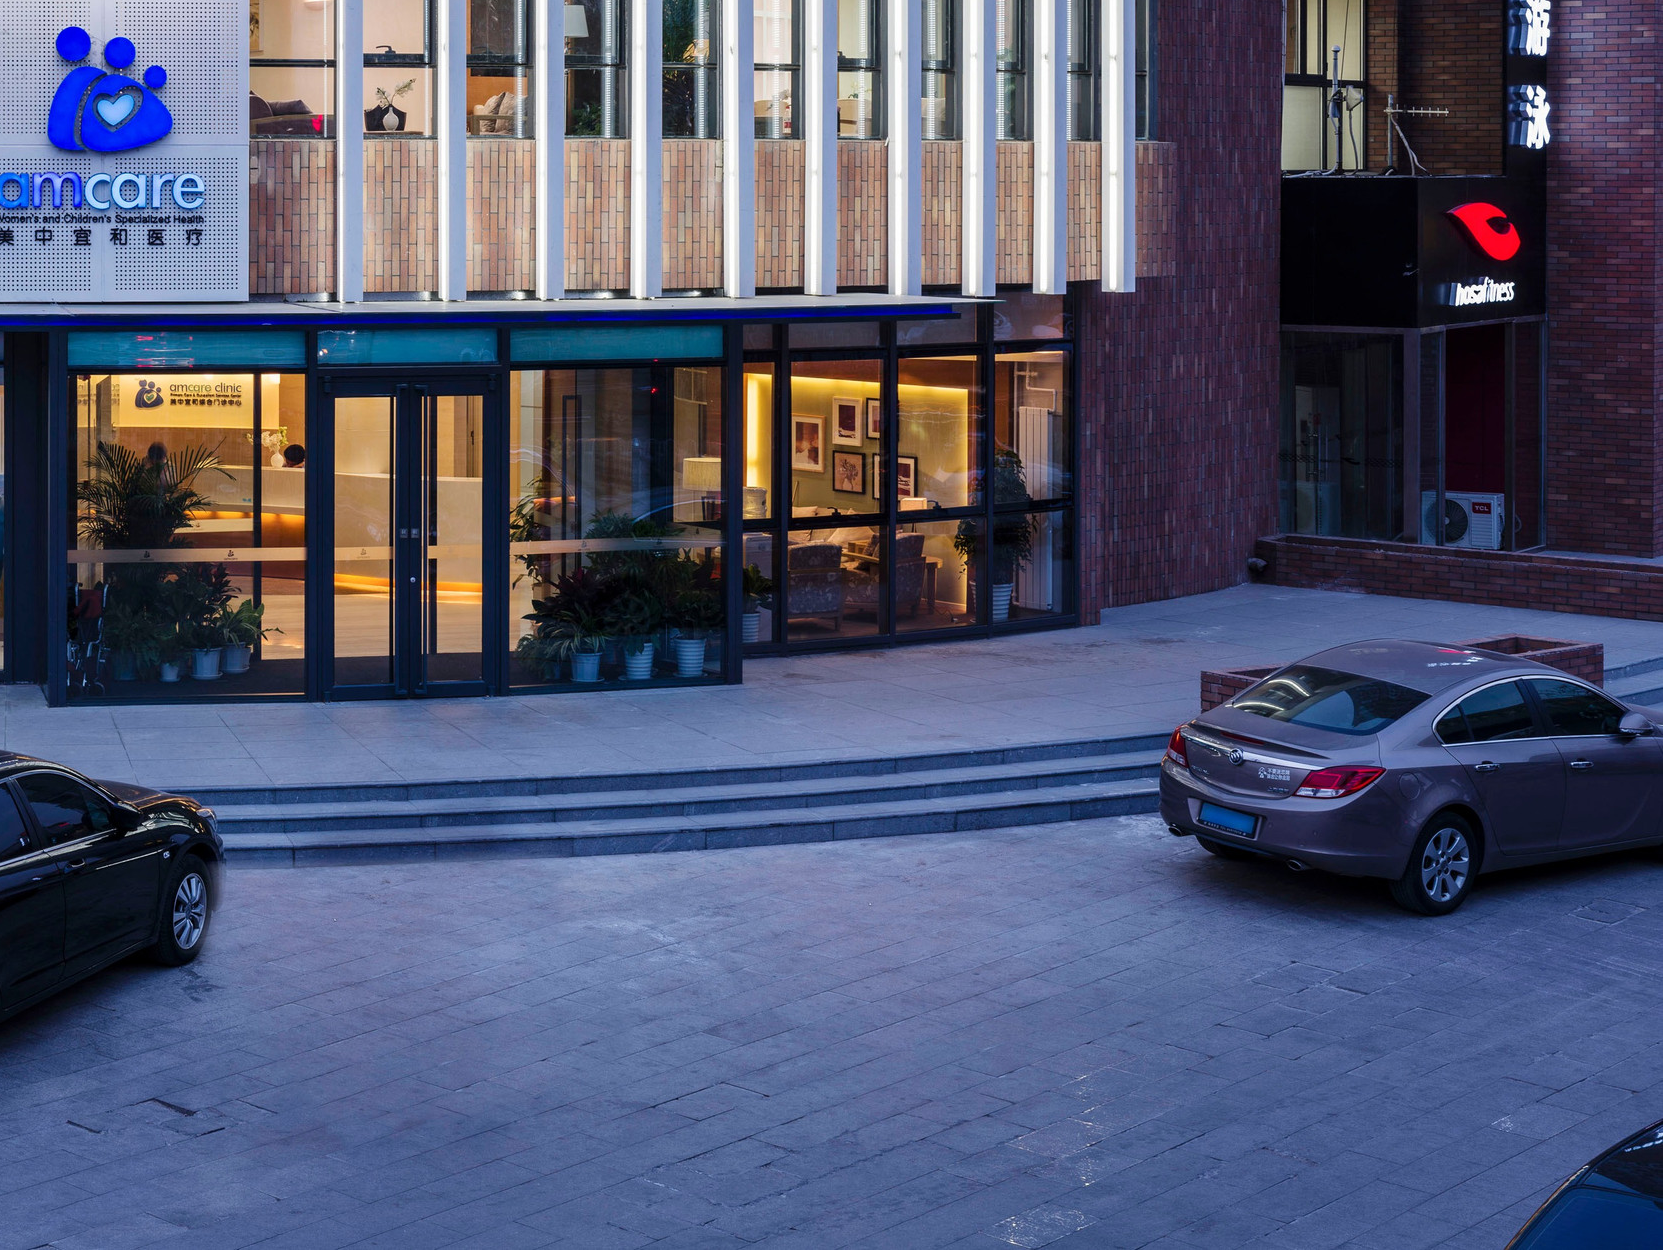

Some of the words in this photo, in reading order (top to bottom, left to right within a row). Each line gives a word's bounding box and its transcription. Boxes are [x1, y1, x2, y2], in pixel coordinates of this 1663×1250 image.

[42, 214, 61, 224] and
[63, 213, 112, 224] Children's
[114, 214, 171, 225] Specialized
[173, 215, 205, 224] Health
[169, 383, 212, 392] amcare
[214, 381, 242, 393] clinic
